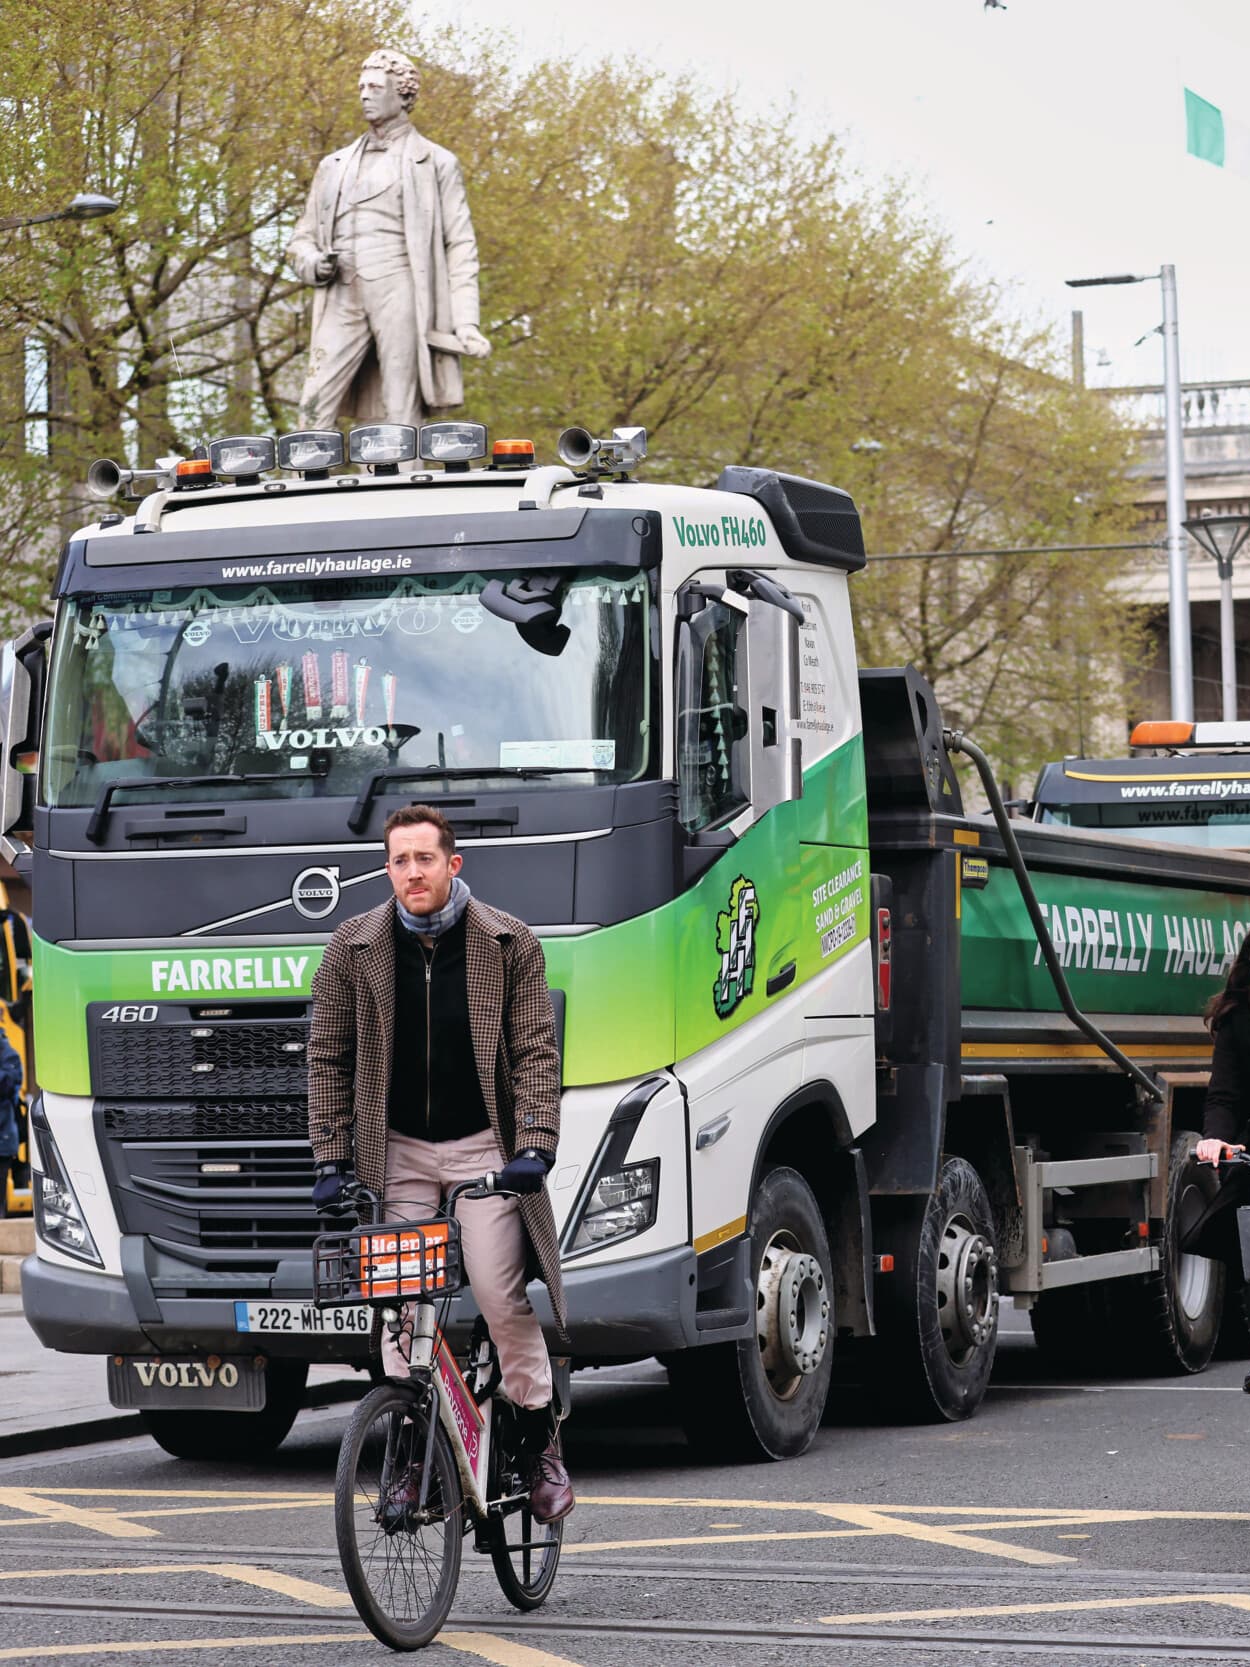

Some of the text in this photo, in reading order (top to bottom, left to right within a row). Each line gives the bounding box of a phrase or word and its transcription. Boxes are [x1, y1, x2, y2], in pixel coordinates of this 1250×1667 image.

[720, 516, 766, 549] FH460
[222, 555, 412, 578] www.farrellyhaulage.ie
[260, 727, 387, 750] VOLVO
[299, 889, 333, 897] VOLVO
[812, 860, 862, 907] SITE CLEARANCE
[815, 887, 863, 933] SAND & GRAVEL
[1034, 902, 1153, 973] FARRELLY
[151, 956, 309, 992] FARRELLY
[101, 1005, 158, 1023] 460
[258, 1308, 368, 1331] 222-MH-646
[133, 1362, 239, 1388] VOLVO
